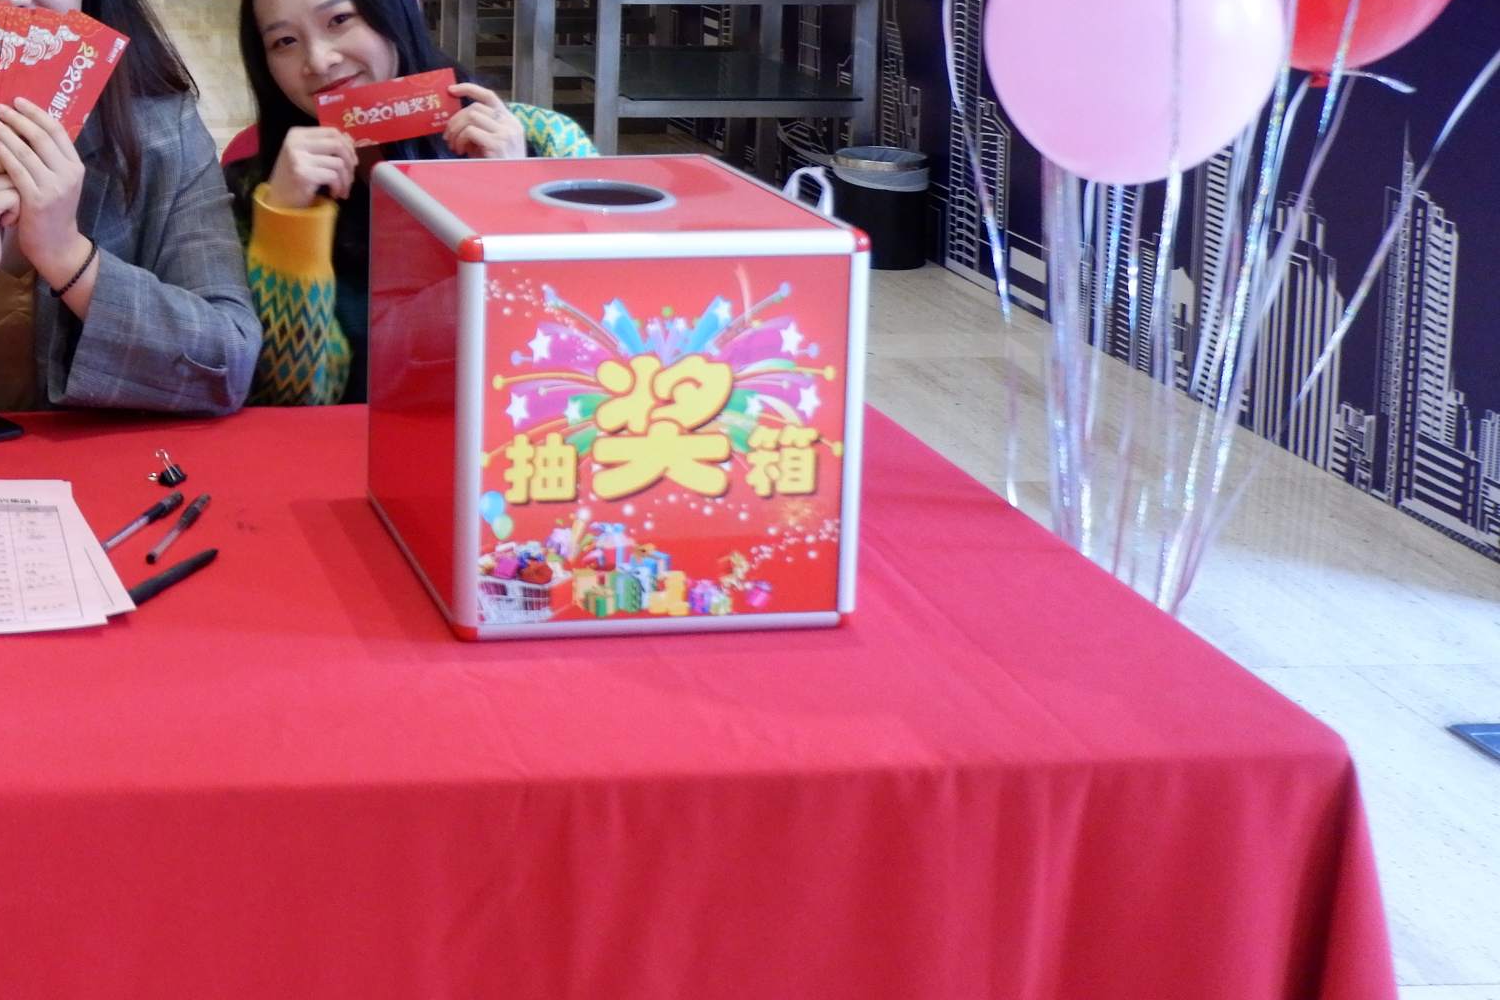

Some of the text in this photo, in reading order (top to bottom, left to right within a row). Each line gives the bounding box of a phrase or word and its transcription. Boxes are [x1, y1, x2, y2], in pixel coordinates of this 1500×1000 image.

[342, 94, 442, 128] 2020抽奖券
[504, 354, 821, 505] 抽奖箱
